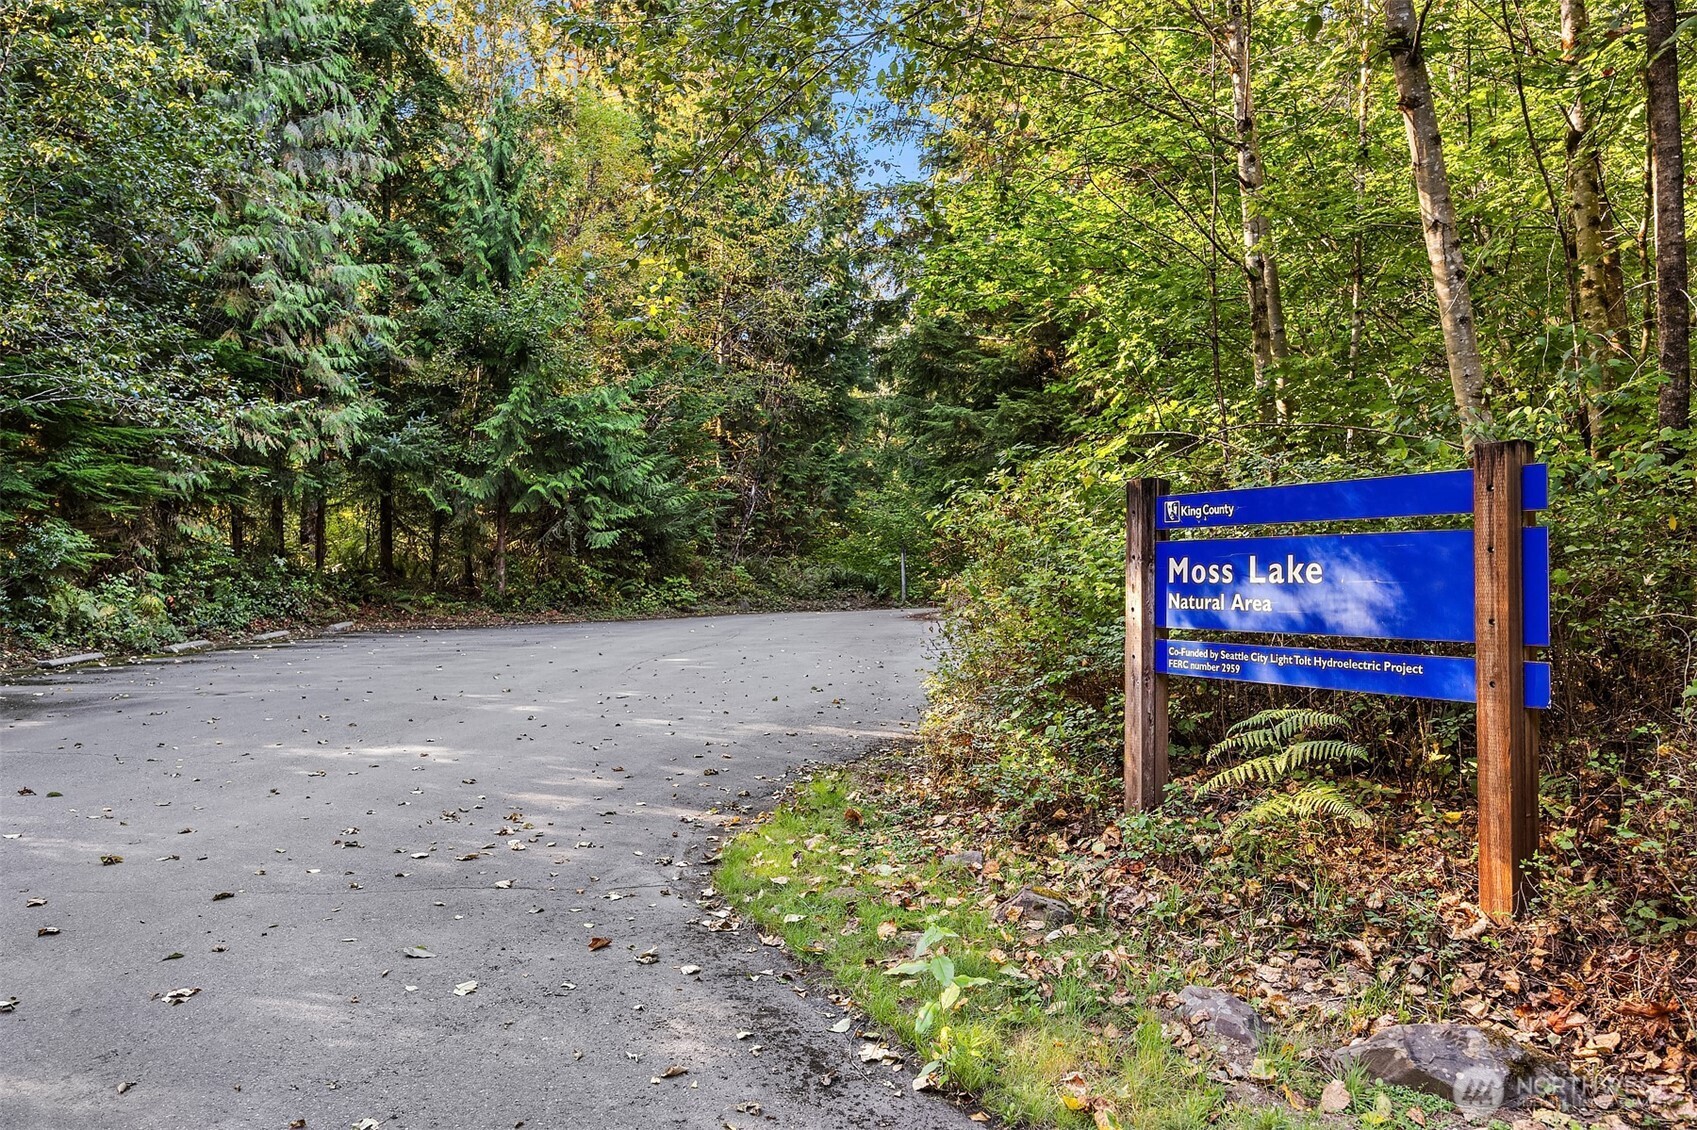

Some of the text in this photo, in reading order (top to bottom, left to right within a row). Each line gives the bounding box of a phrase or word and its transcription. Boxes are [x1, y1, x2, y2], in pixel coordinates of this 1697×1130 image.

[1181, 503, 1234, 519] King County
[1168, 554, 1323, 584] Moss Lake
[1168, 592, 1273, 612] Natural Area
[1168, 646, 1424, 676] Co-Funded by Seattle City Light Tolt Hydroelectric Project
[1168, 659, 1241, 674] FERC number 2959
